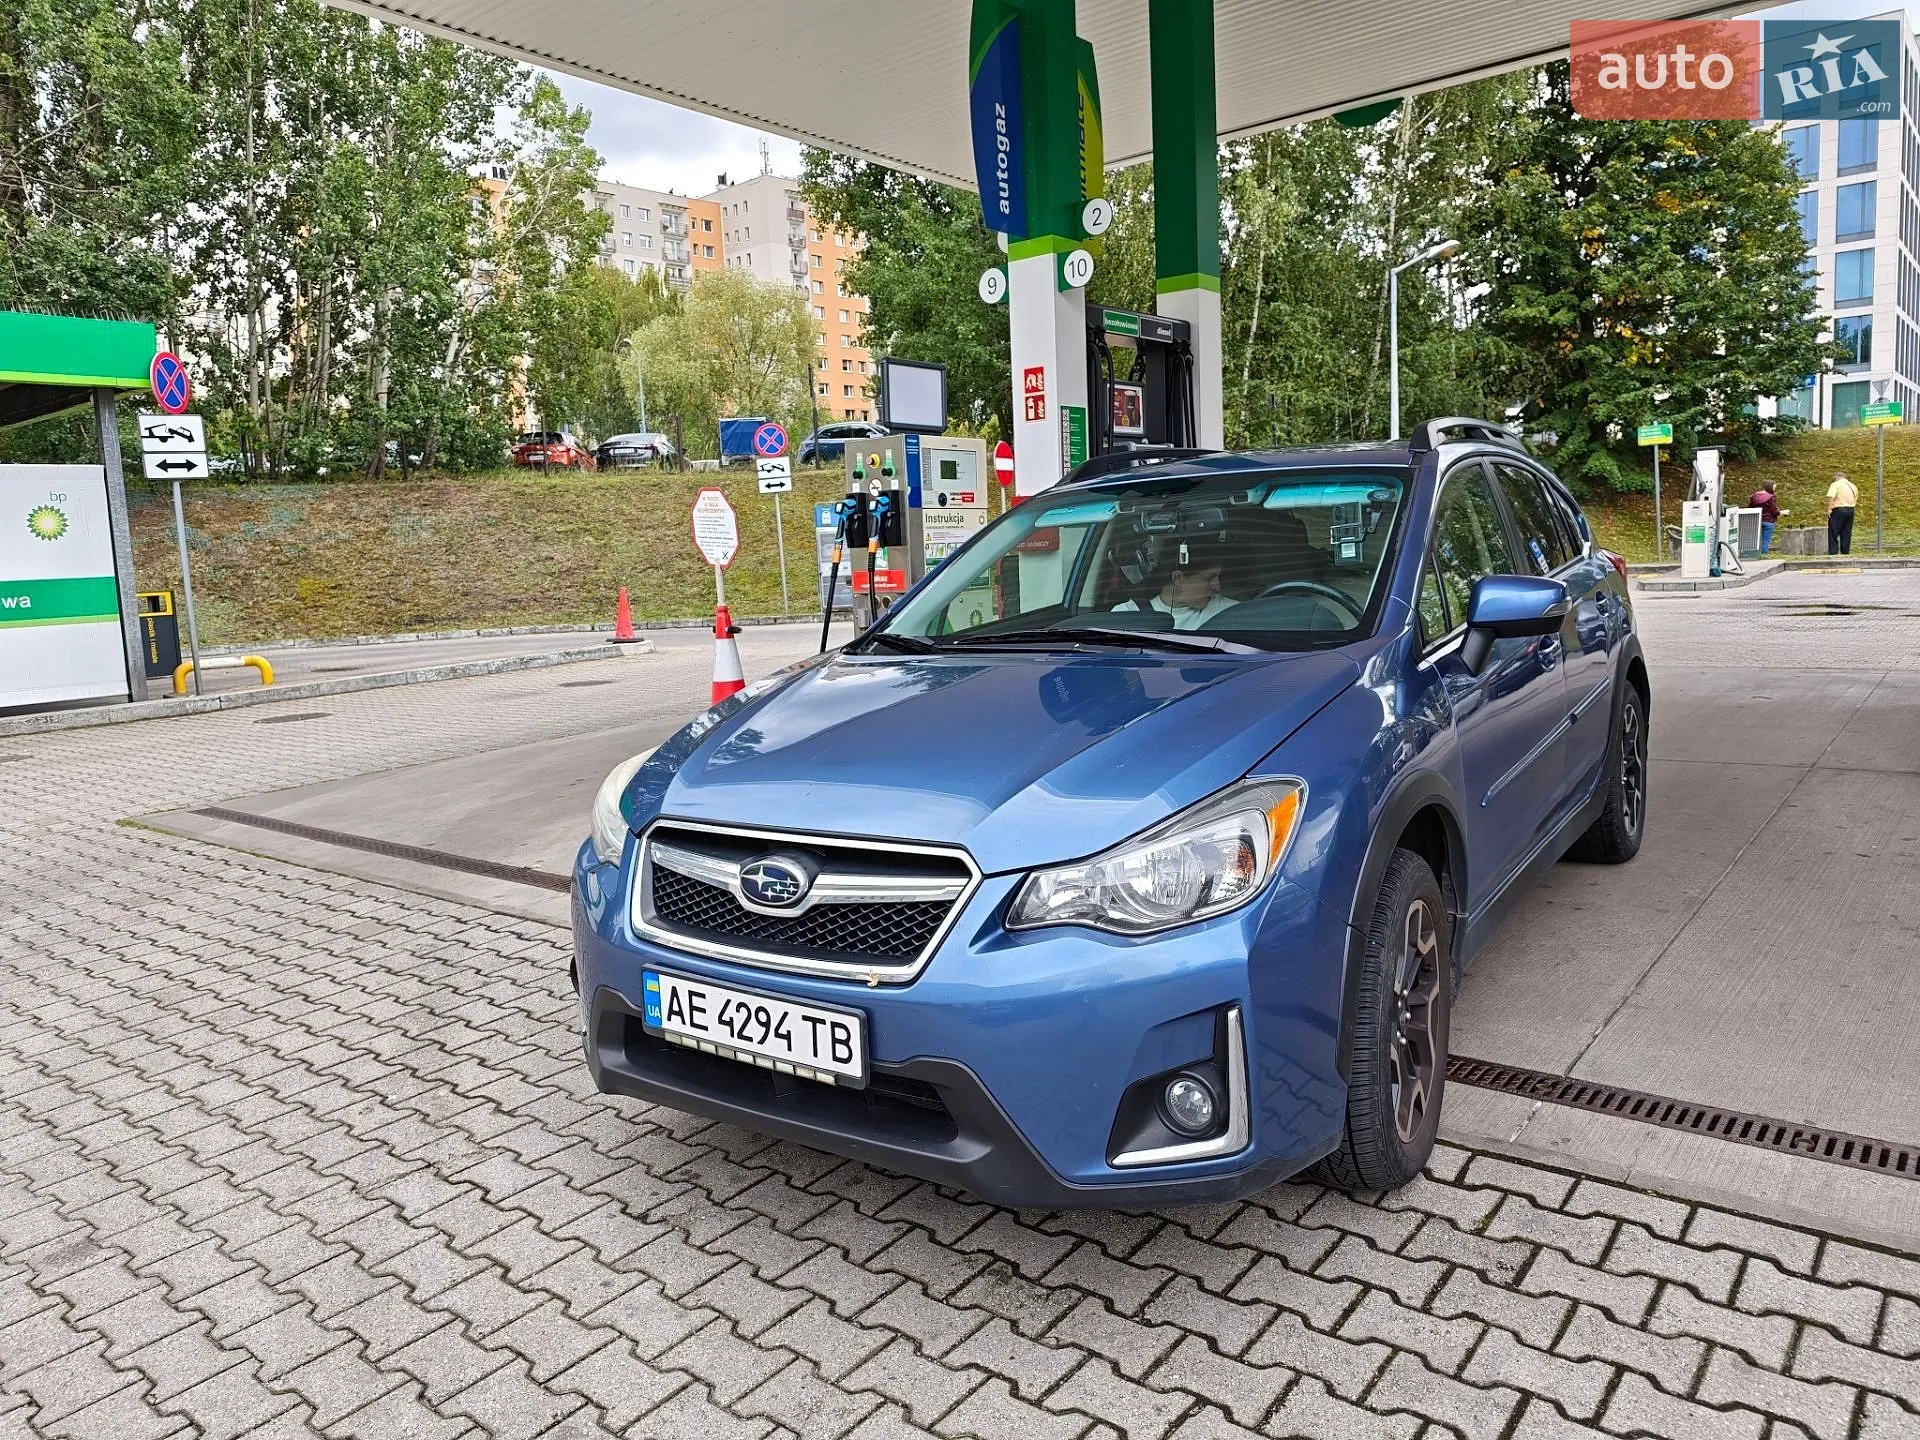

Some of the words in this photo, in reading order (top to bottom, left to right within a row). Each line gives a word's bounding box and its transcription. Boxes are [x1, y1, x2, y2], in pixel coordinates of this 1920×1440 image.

[995, 102, 1010, 215] autogaz
[1092, 207, 1103, 227] 2
[1068, 258, 1088, 279] 10
[987, 276, 998, 295] 9
[49, 490, 68, 504] bp
[925, 512, 965, 525] Instrukcja
[648, 1004, 661, 1018] UA
[666, 985, 709, 1032] AE
[717, 998, 792, 1052] 4294
[801, 1014, 854, 1065] TB
